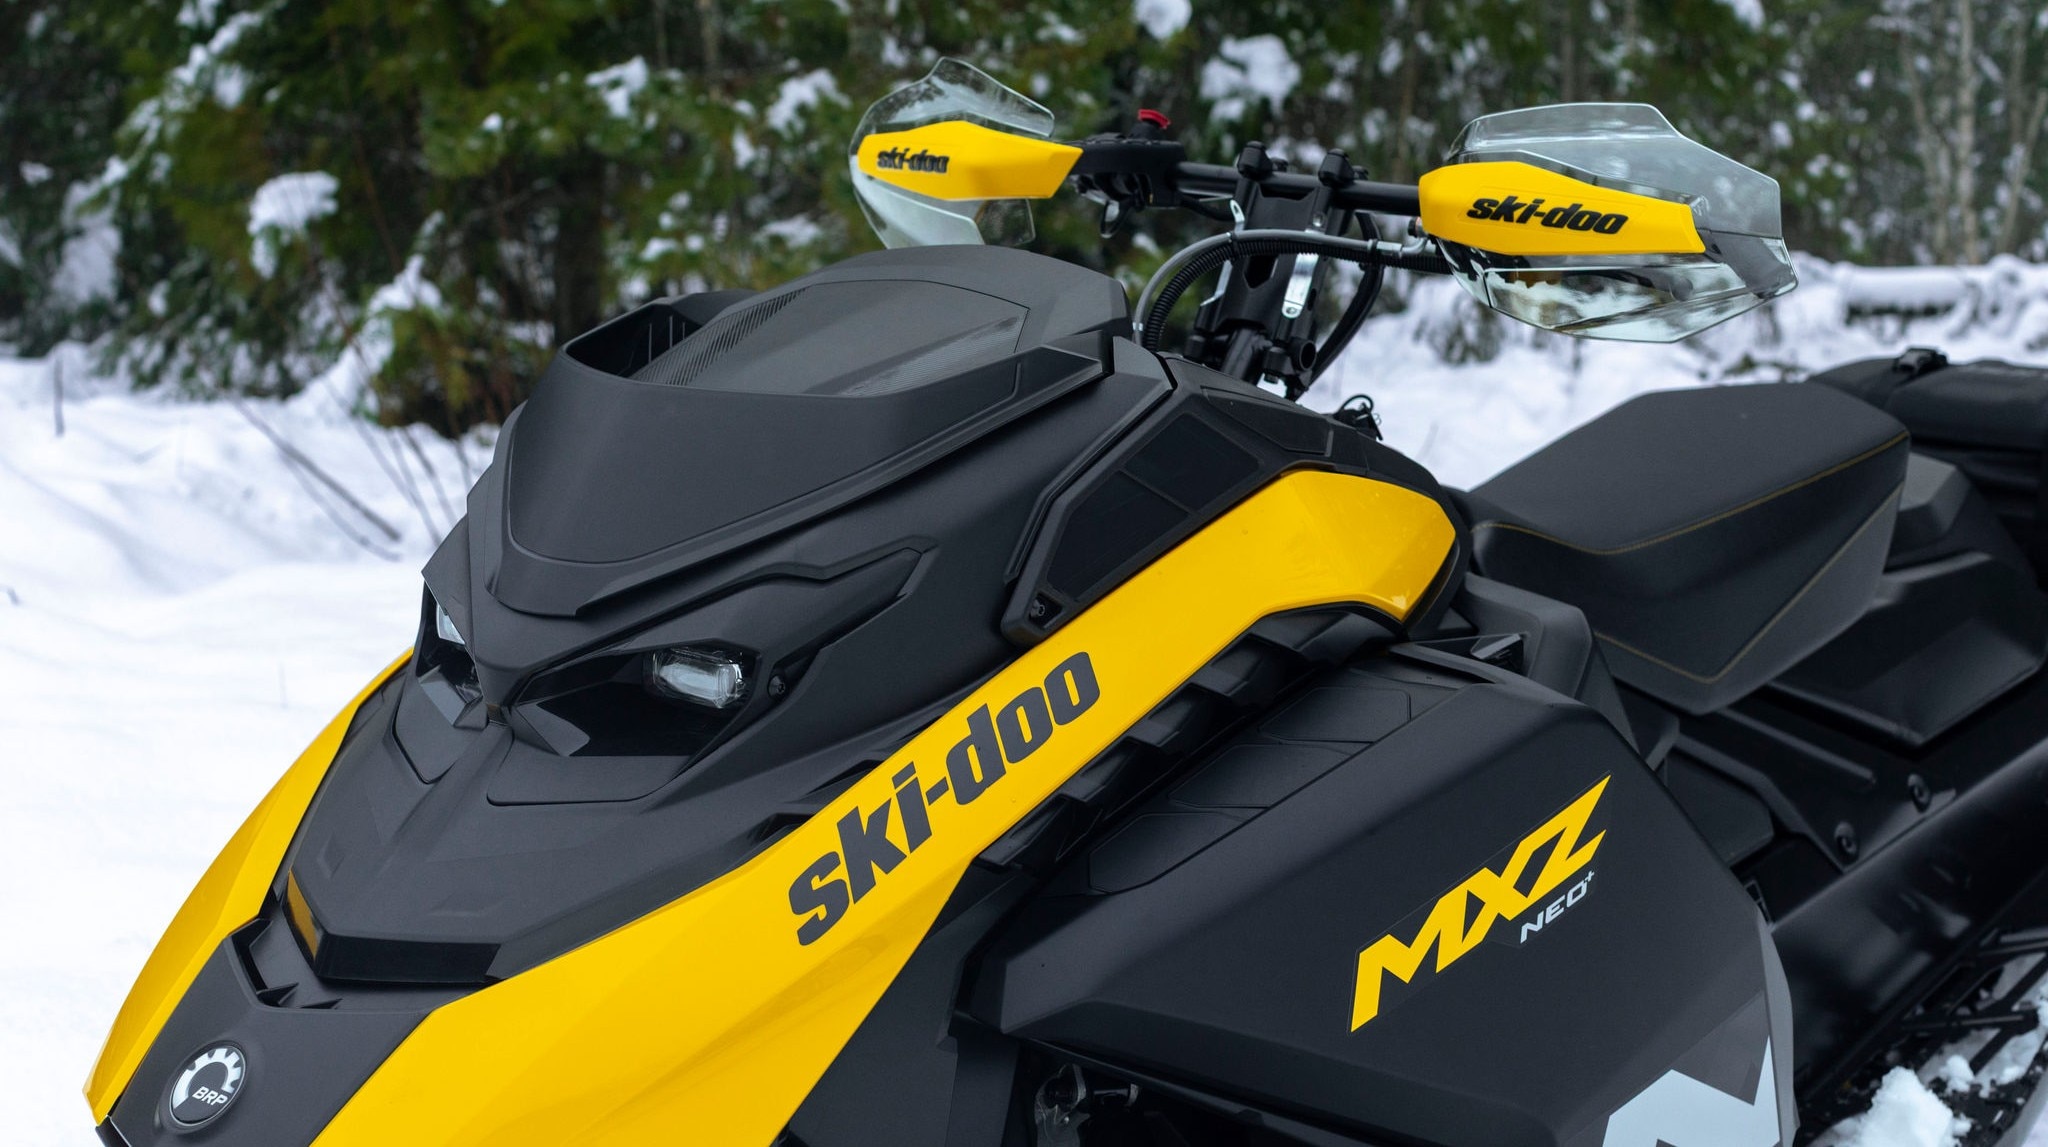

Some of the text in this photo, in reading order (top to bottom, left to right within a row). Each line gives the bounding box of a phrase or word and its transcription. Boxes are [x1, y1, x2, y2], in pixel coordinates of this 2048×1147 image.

[877, 147, 950, 174] ski-doo
[1466, 195, 1629, 235] ski-doo
[788, 651, 1101, 946] ski-doo
[1350, 775, 1611, 1033] MXZ
[192, 1086, 228, 1105] BRP
